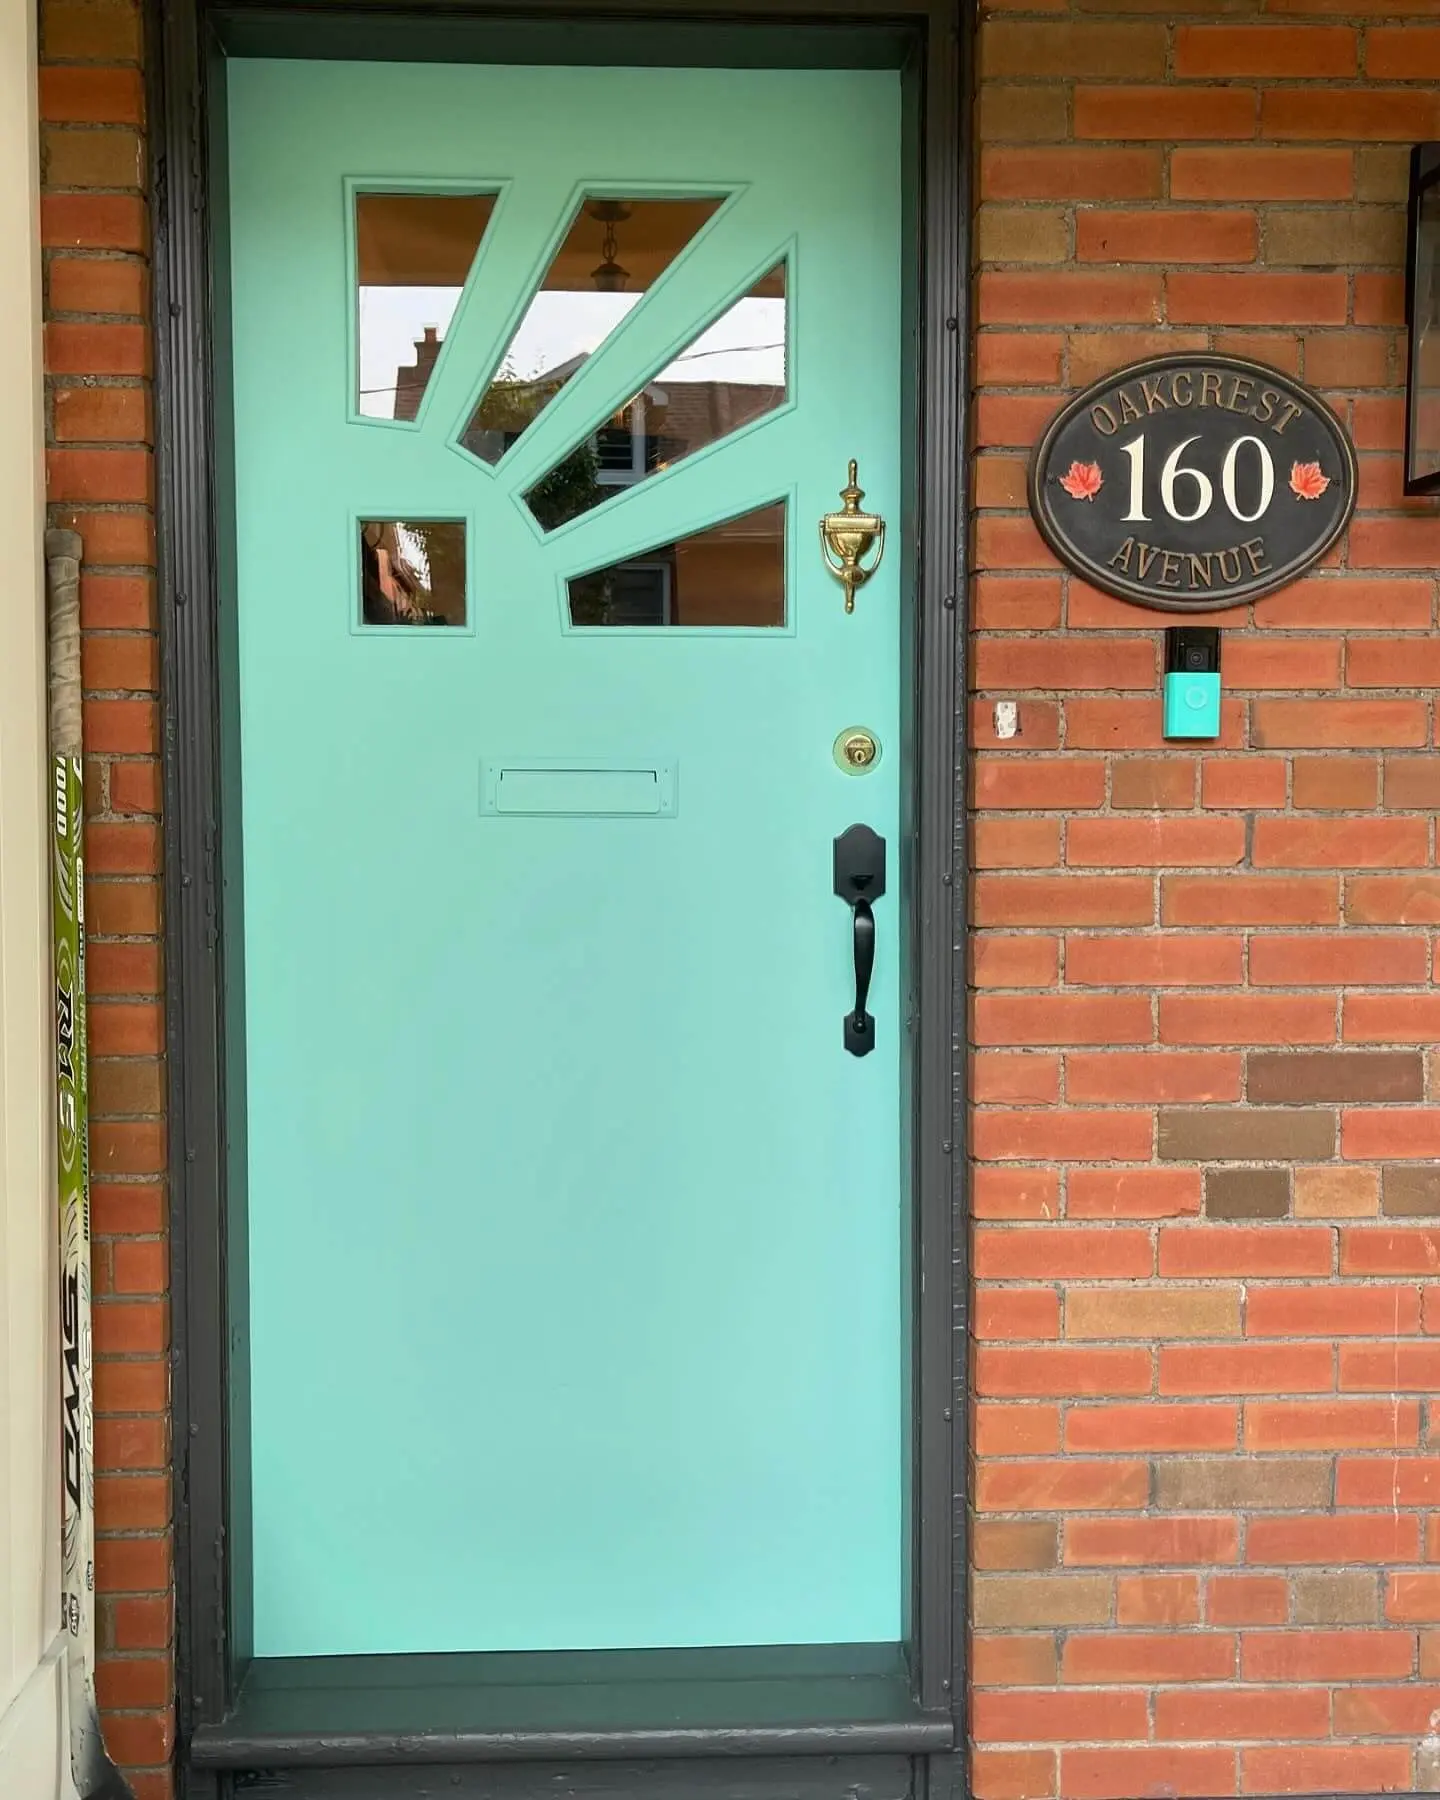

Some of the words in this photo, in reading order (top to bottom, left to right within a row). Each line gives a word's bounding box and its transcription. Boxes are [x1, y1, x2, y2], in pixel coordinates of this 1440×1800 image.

[1090, 371, 1305, 436] OAKCREST
[1120, 433, 1275, 522] 160
[1107, 536, 1273, 590] AVENUE
[79, 1003, 88, 1092] RHYTHM
